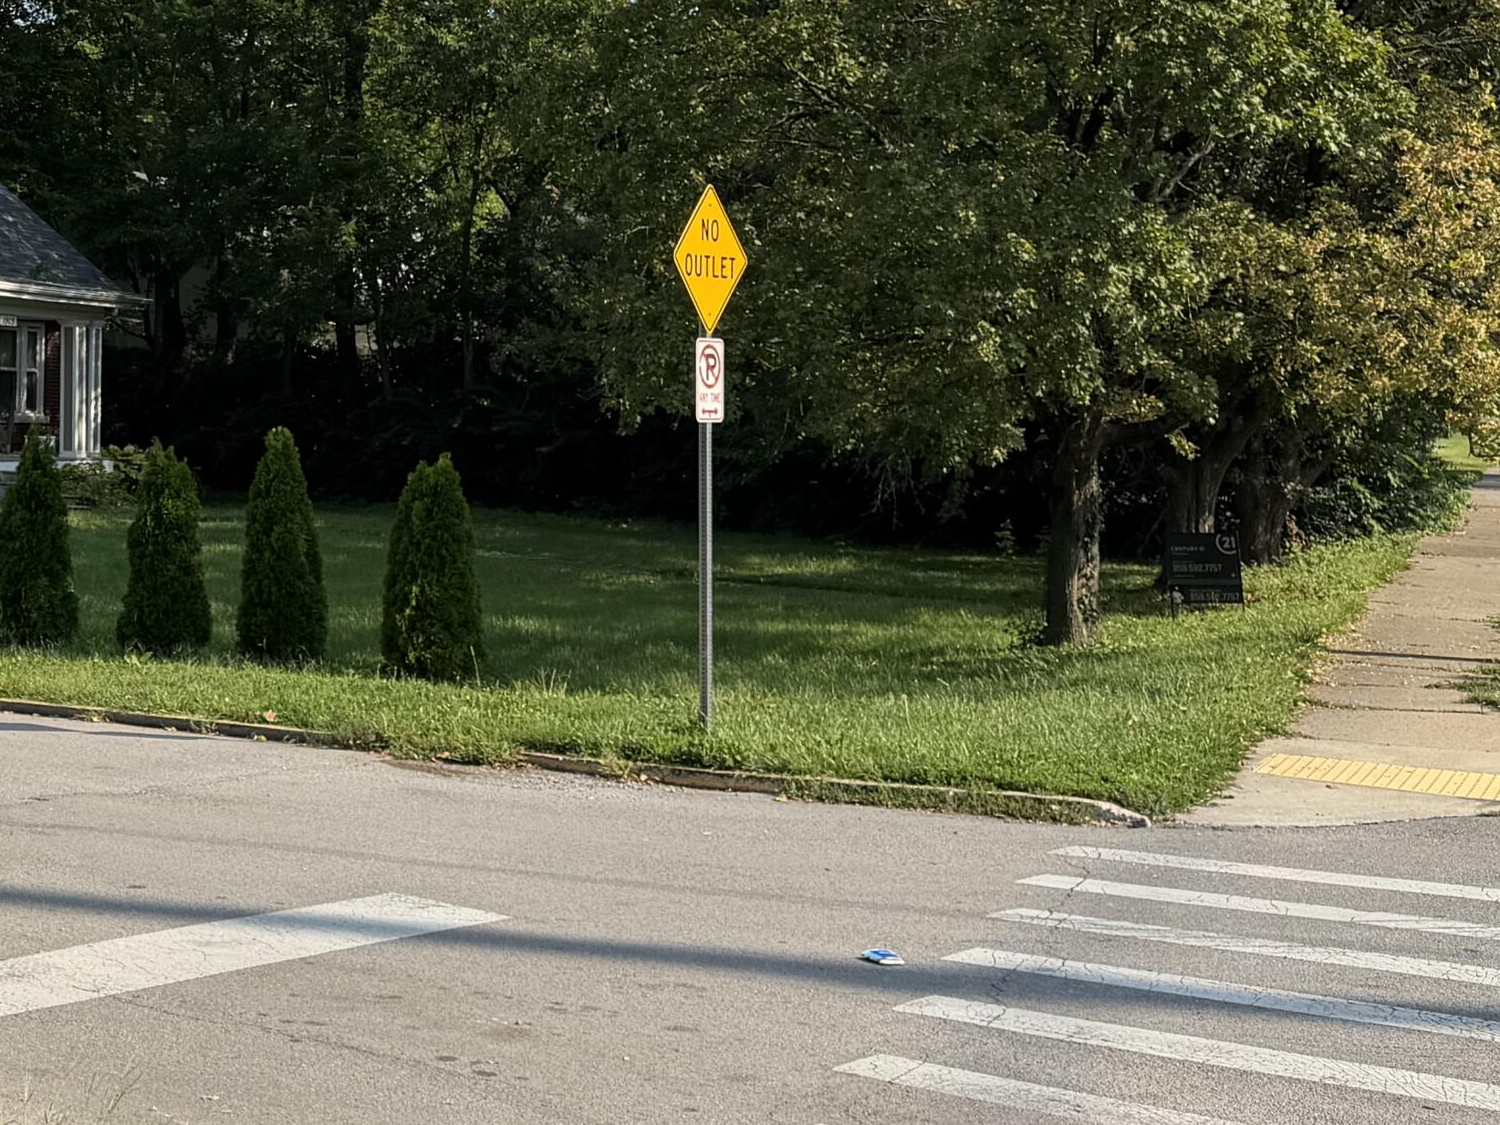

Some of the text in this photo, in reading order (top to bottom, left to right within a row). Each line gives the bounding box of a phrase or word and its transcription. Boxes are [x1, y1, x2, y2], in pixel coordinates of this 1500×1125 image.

[701, 218, 719, 242] NO
[685, 253, 736, 279] OUTLET
[1221, 536, 1236, 548] 21
